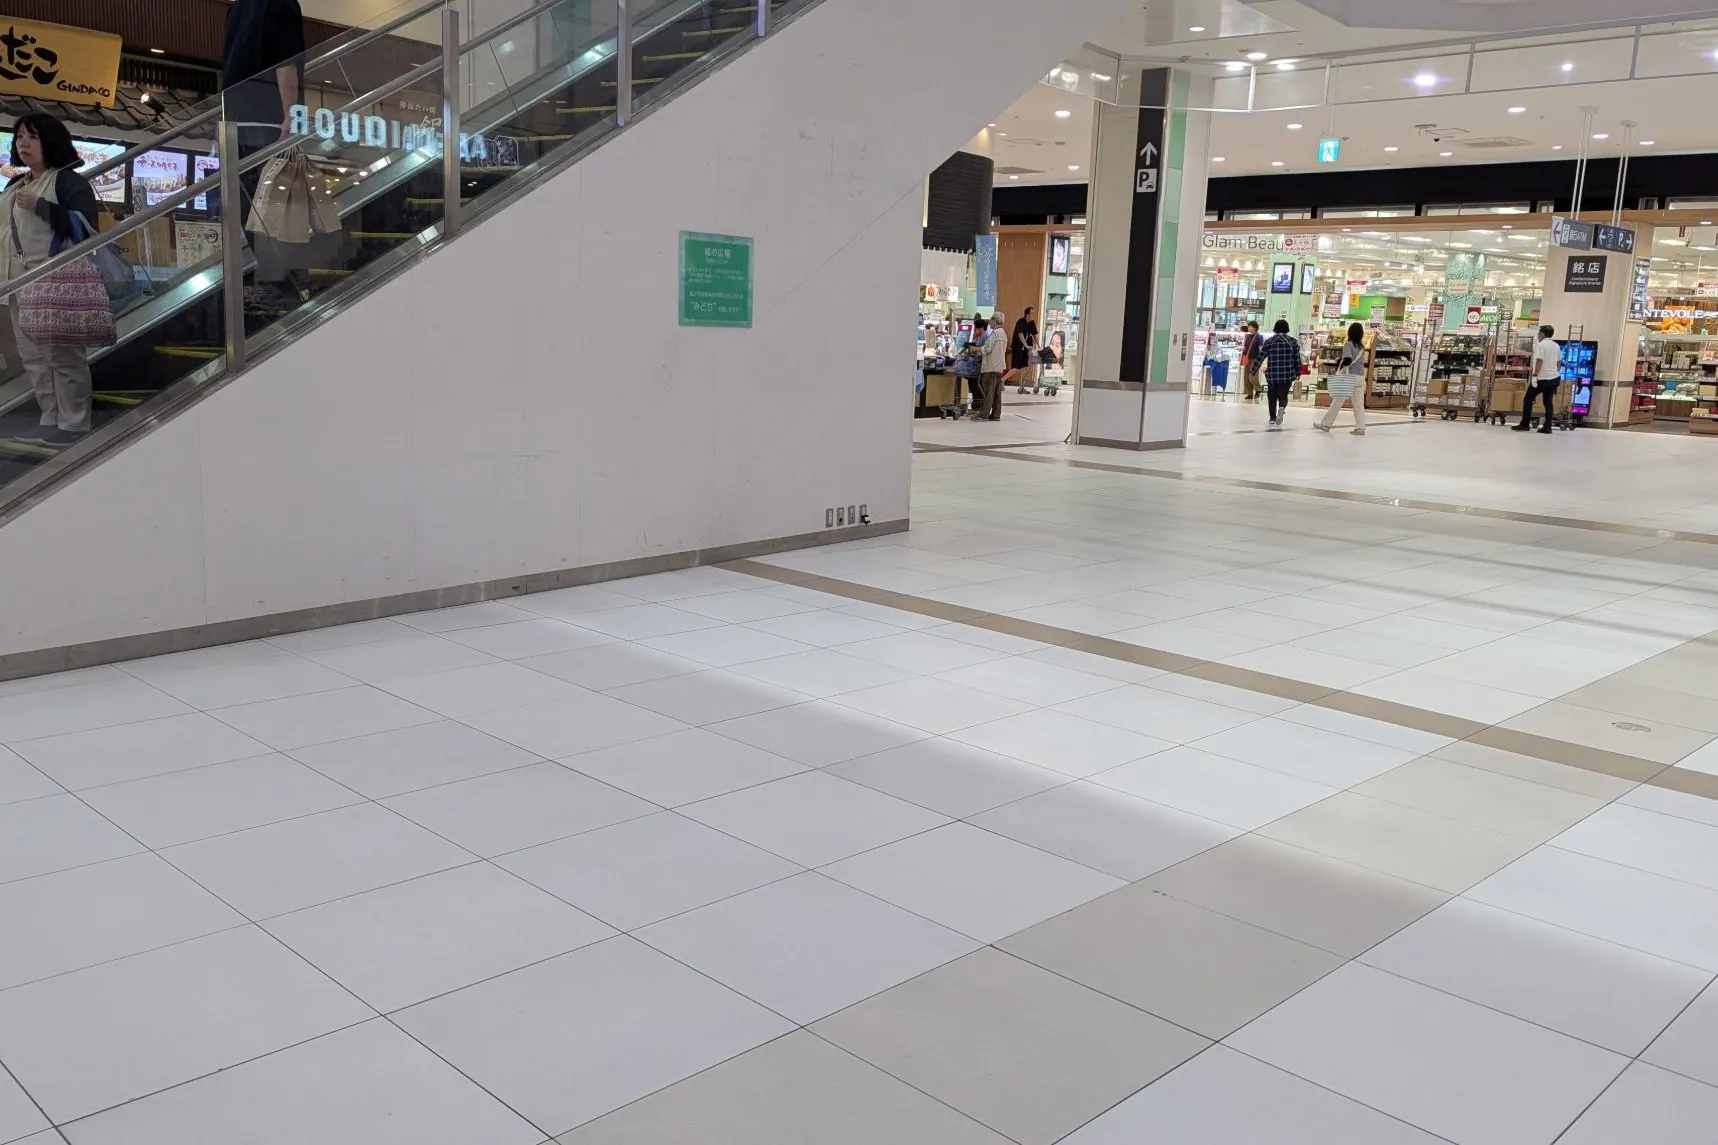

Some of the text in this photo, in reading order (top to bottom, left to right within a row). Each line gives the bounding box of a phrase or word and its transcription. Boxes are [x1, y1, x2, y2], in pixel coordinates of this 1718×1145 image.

[56, 79, 111, 97] GINDACO
[1138, 171, 1149, 188] P
[1203, 234, 1243, 249] Glam
[1248, 235, 1284, 250] Beau
